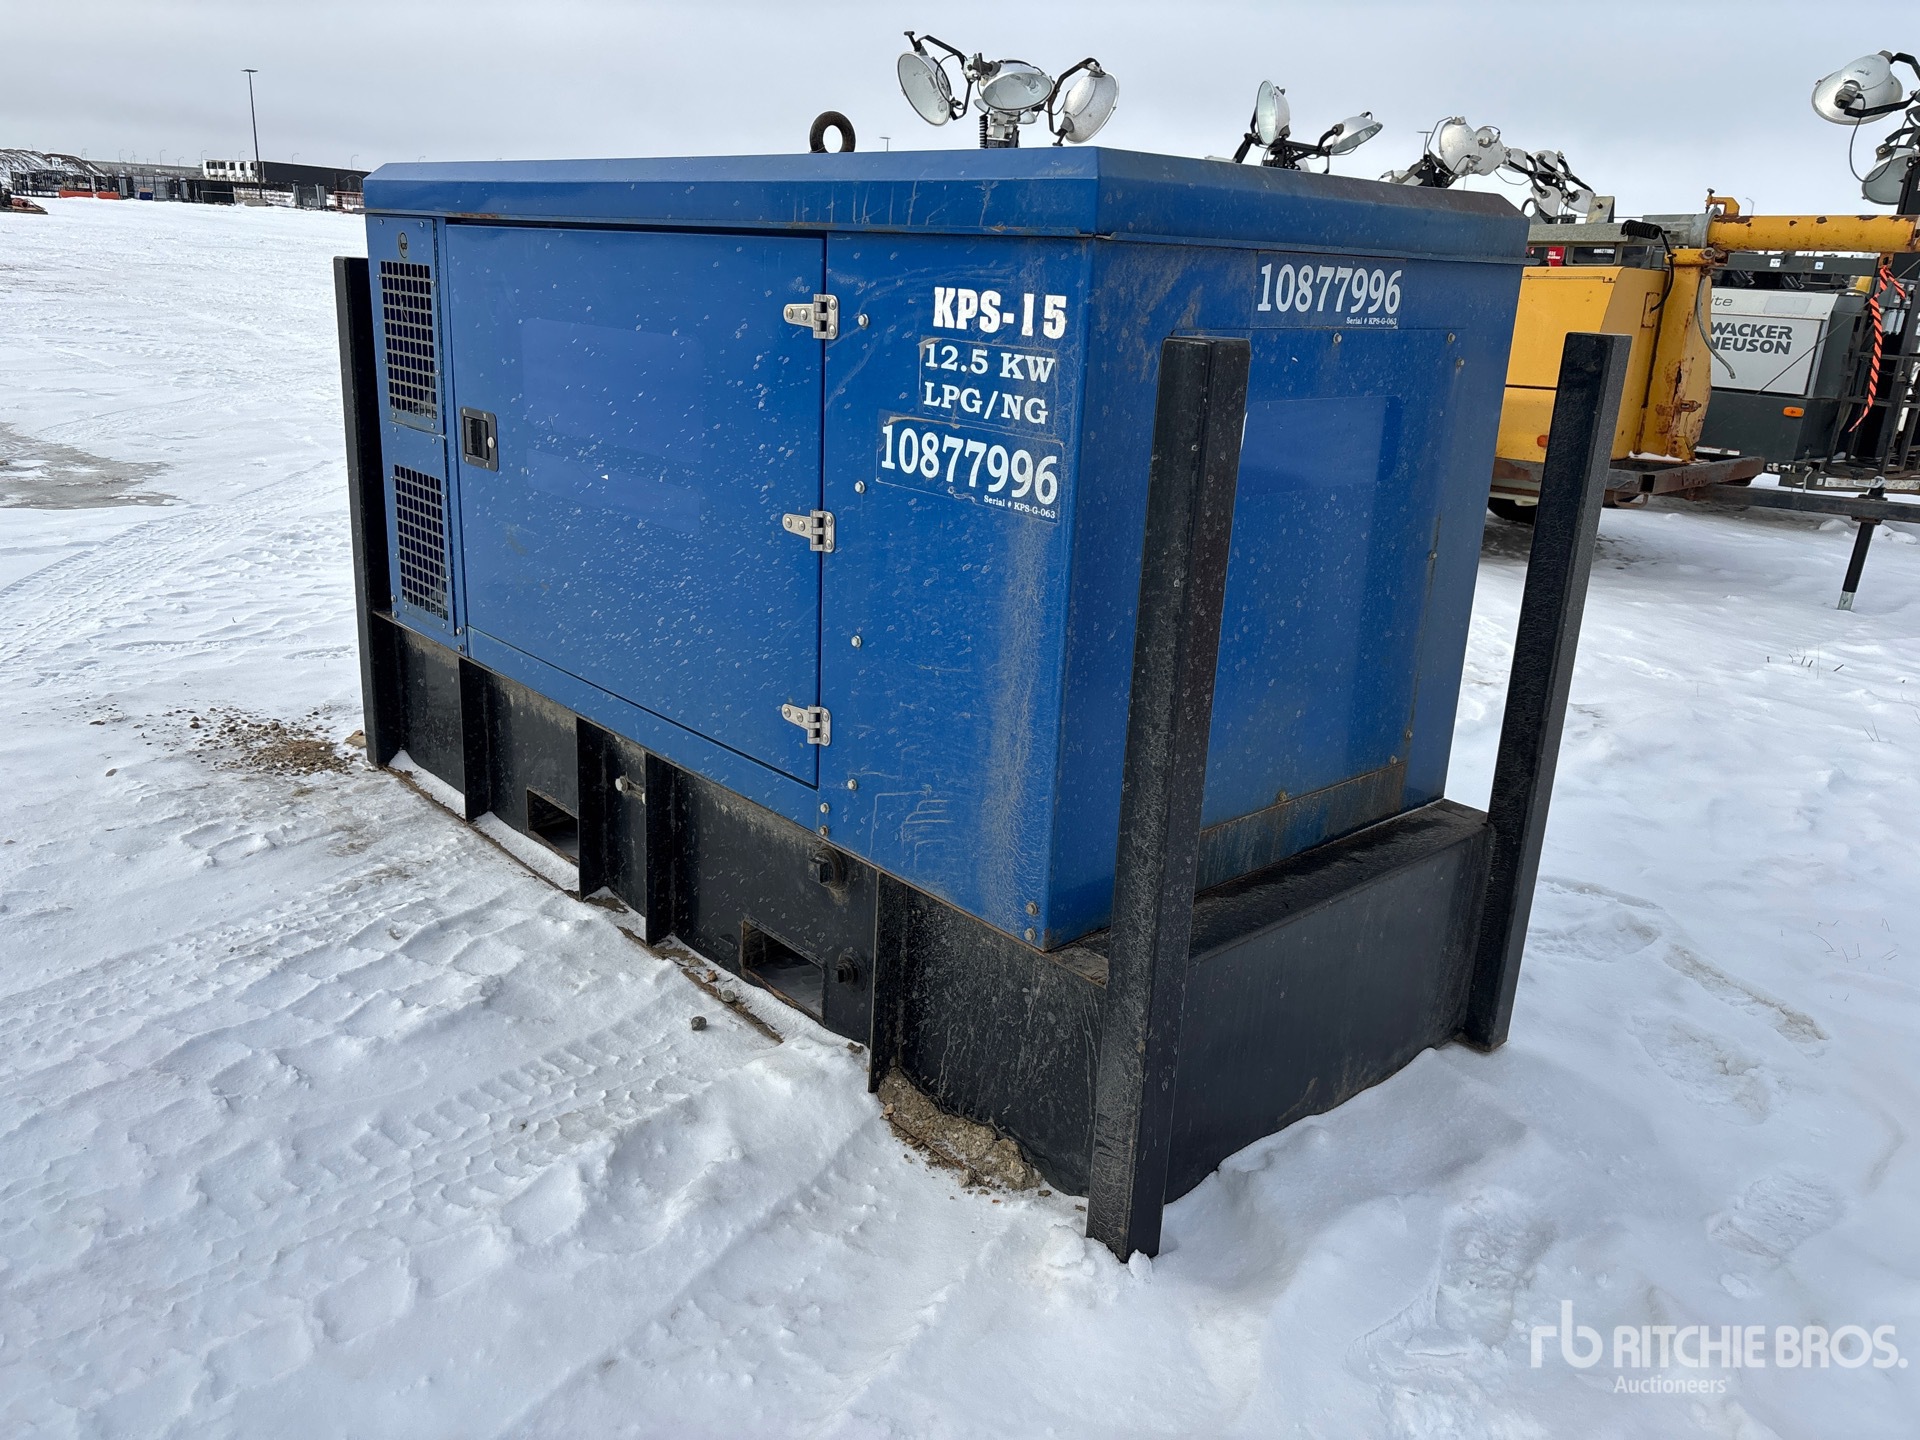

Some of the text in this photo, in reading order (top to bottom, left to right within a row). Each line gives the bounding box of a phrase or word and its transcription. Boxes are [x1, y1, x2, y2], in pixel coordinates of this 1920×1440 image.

[1257, 263, 1402, 315] 10877996
[933, 286, 1067, 340] KPS-15
[1346, 316, 1363, 325] Serial
[1368, 317, 1398, 326] KPS-G-063
[1711, 321, 1793, 340] WACKER
[925, 343, 1055, 384] 12.5 KW
[923, 381, 1049, 425] LPG/NG
[881, 423, 1058, 505] 10877996
[983, 494, 1006, 507] Serial
[1013, 502, 1056, 519] KPS-G-063
